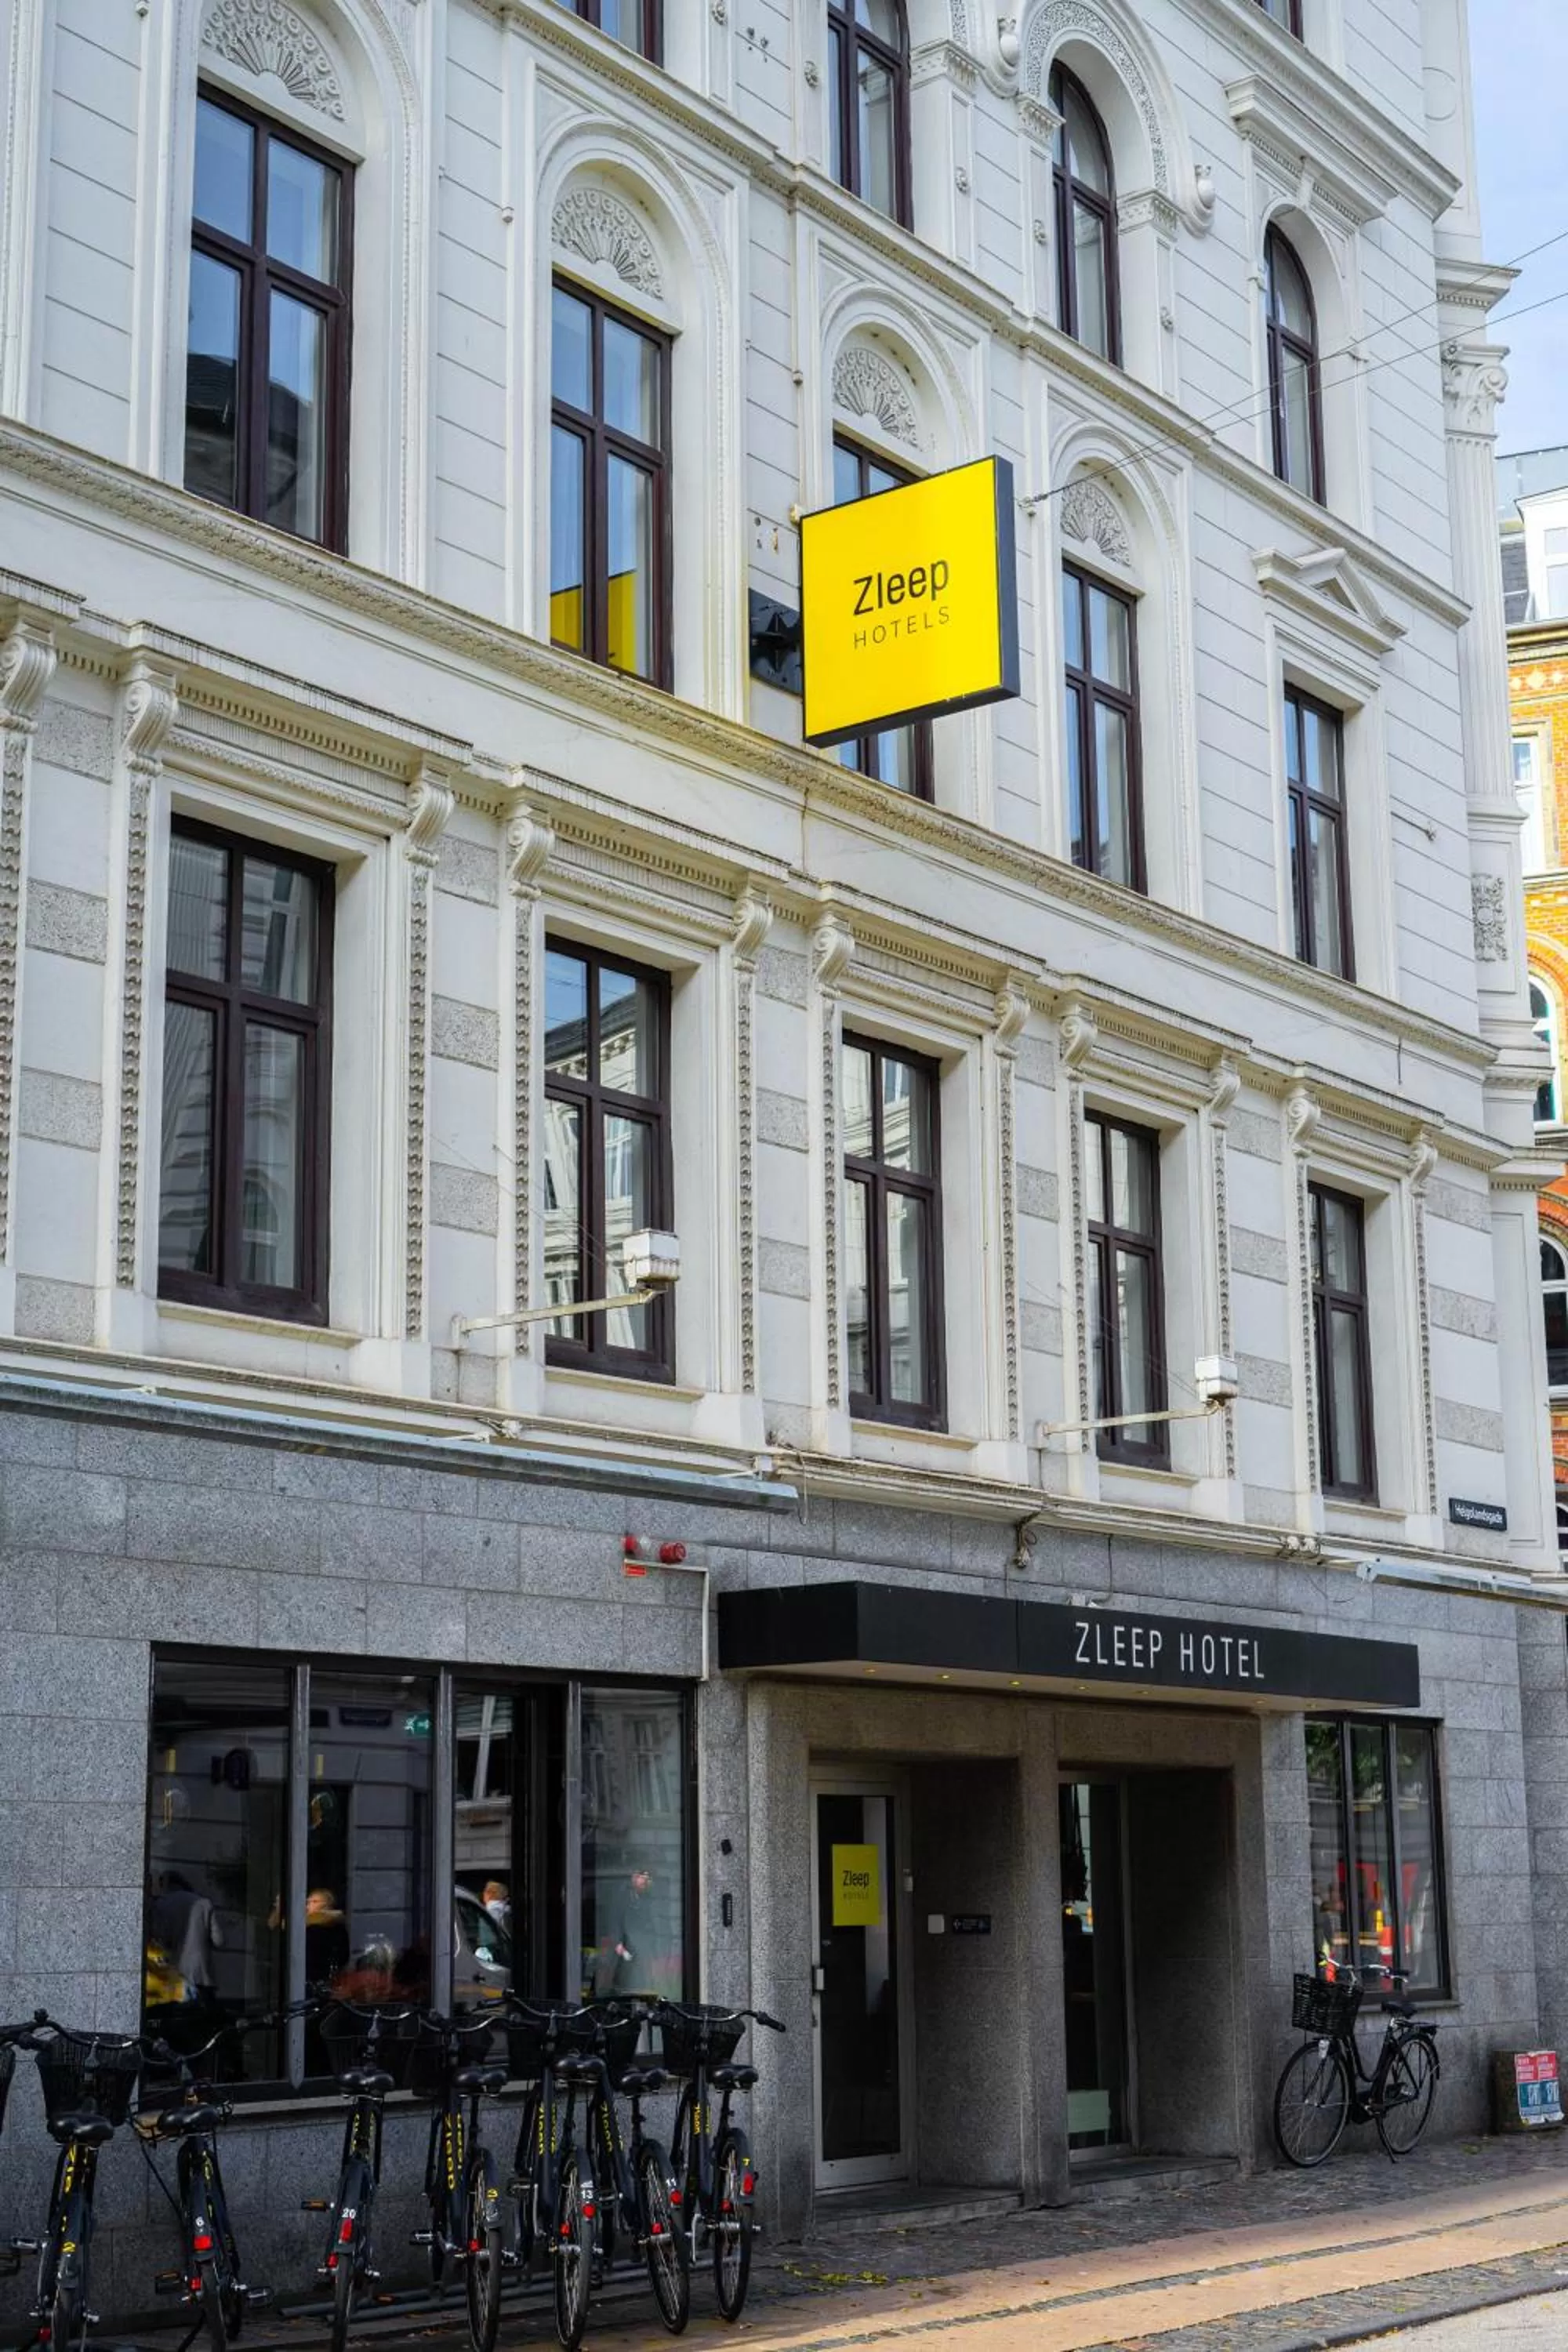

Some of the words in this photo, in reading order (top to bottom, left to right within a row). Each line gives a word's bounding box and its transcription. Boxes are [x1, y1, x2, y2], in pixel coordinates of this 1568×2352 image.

[853, 559, 949, 615] Zleep
[853, 606, 951, 649] HOTELS
[1075, 1621, 1163, 1669] ZLEEP
[1179, 1632, 1265, 1679] HOTEL
[843, 1870, 869, 1888] Zleep
[341, 2207, 358, 2220] 20
